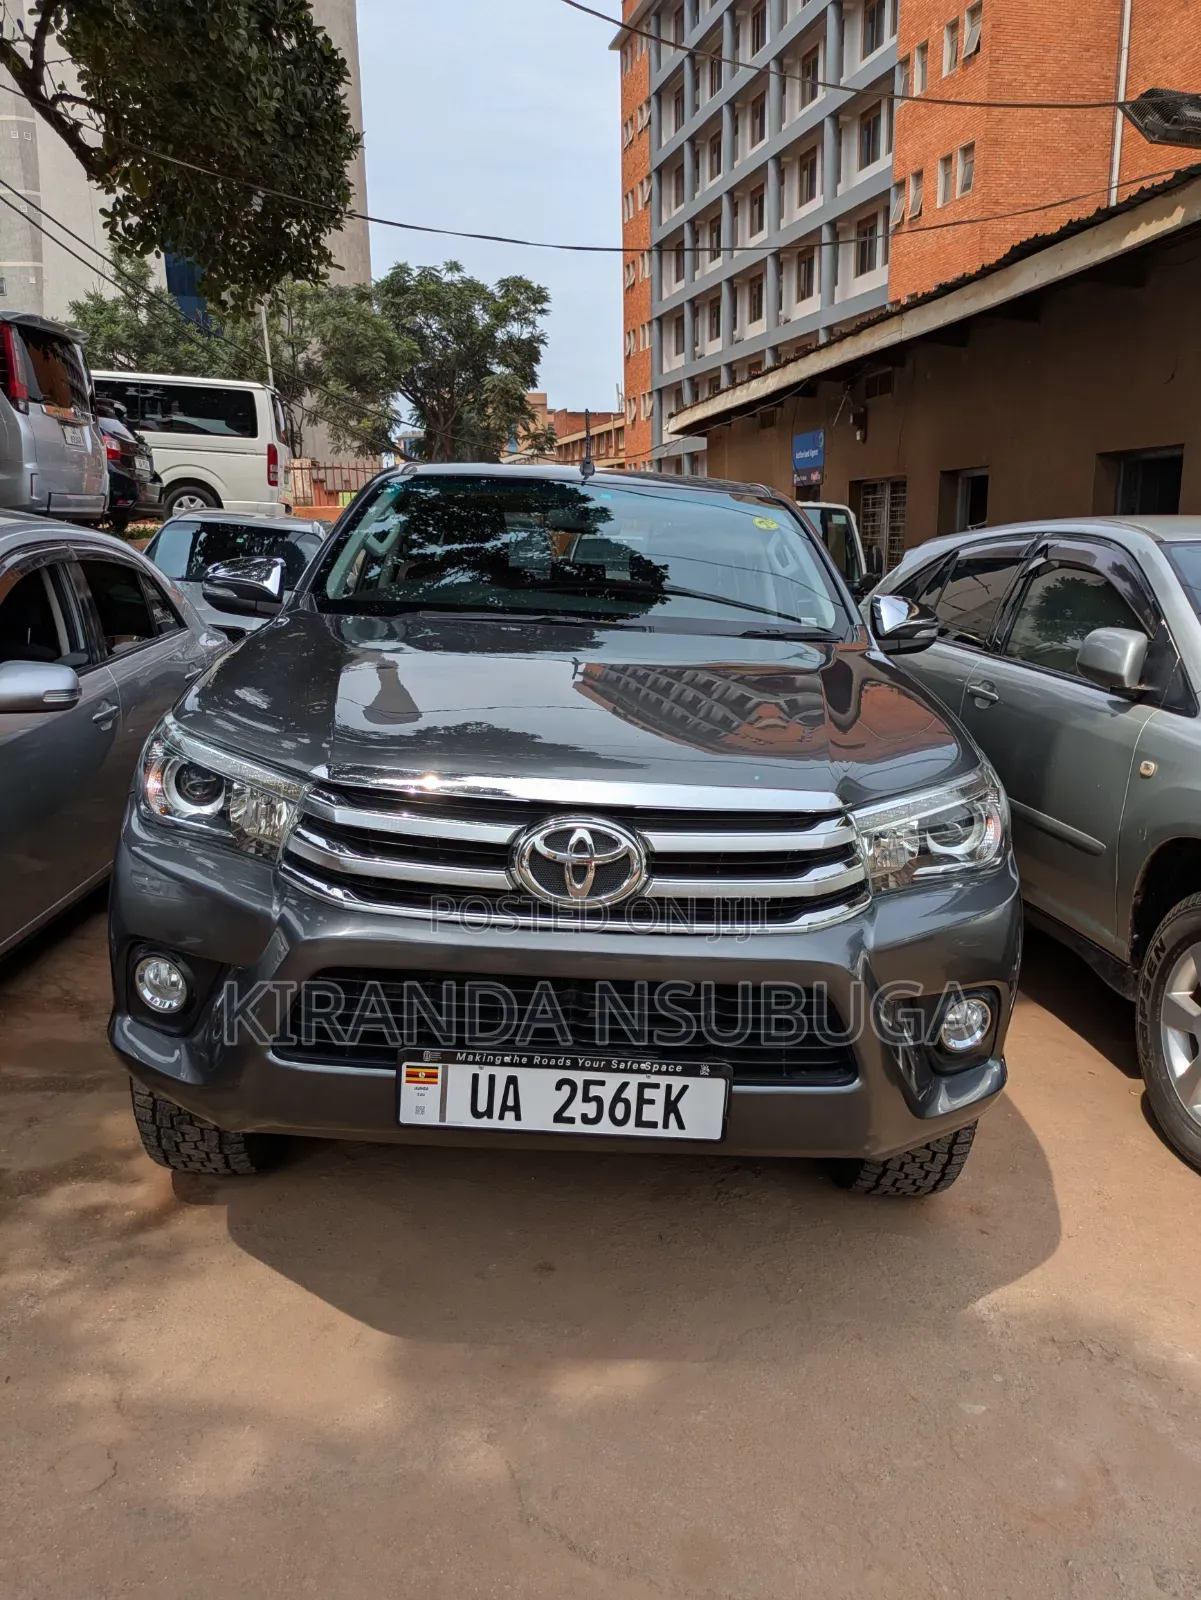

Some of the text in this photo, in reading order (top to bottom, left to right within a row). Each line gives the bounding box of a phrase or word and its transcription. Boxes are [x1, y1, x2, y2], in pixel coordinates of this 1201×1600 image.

[456, 1052, 683, 1074] Making the Roads Your Safe Space
[469, 1072, 690, 1131] UA 256EK
